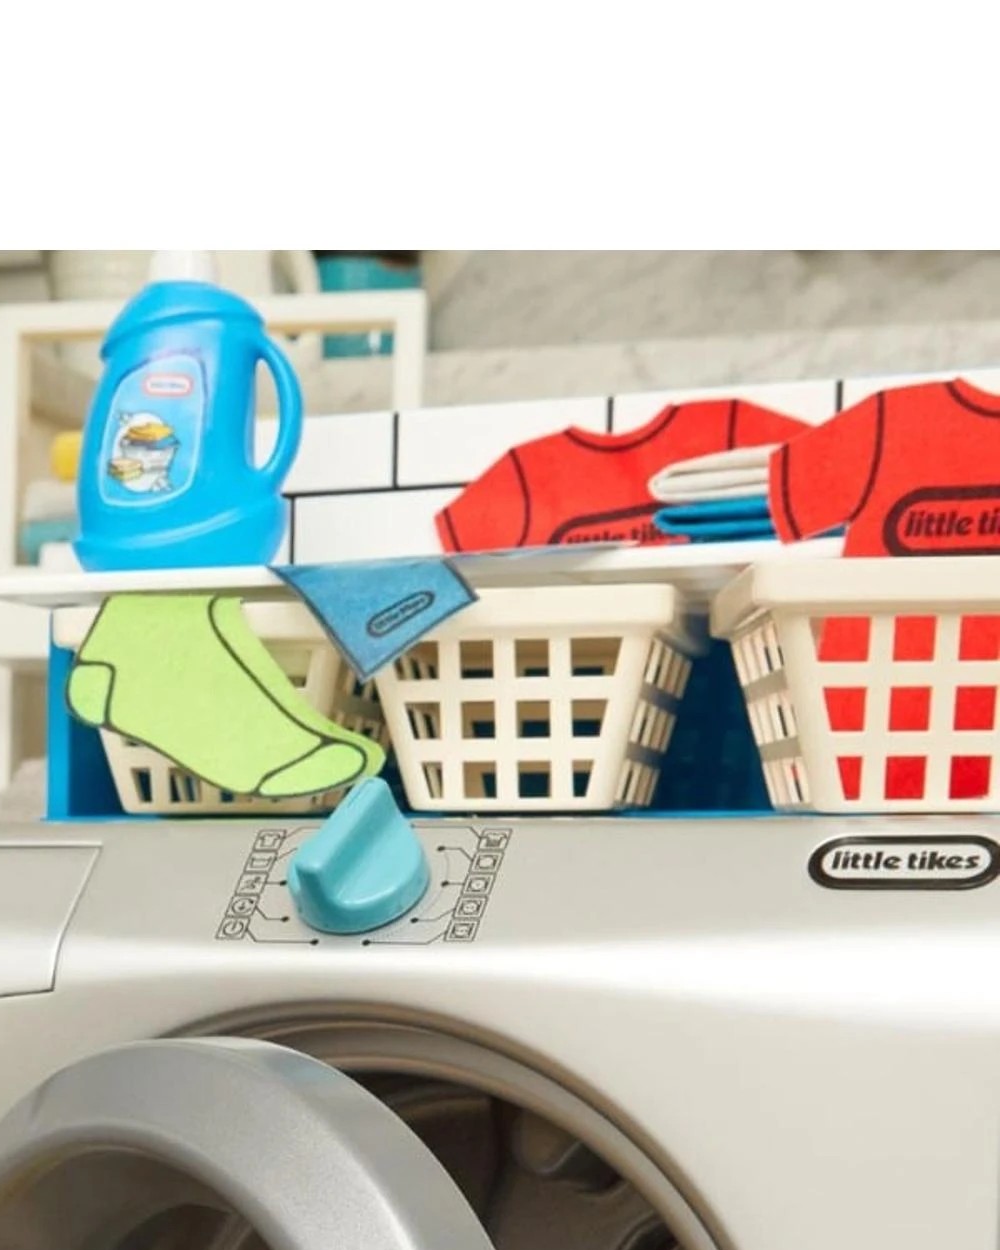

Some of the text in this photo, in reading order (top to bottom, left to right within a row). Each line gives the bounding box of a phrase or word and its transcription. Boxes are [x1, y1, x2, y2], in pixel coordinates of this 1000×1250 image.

[904, 509, 974, 537] little
[831, 850, 981, 871] little tikes
